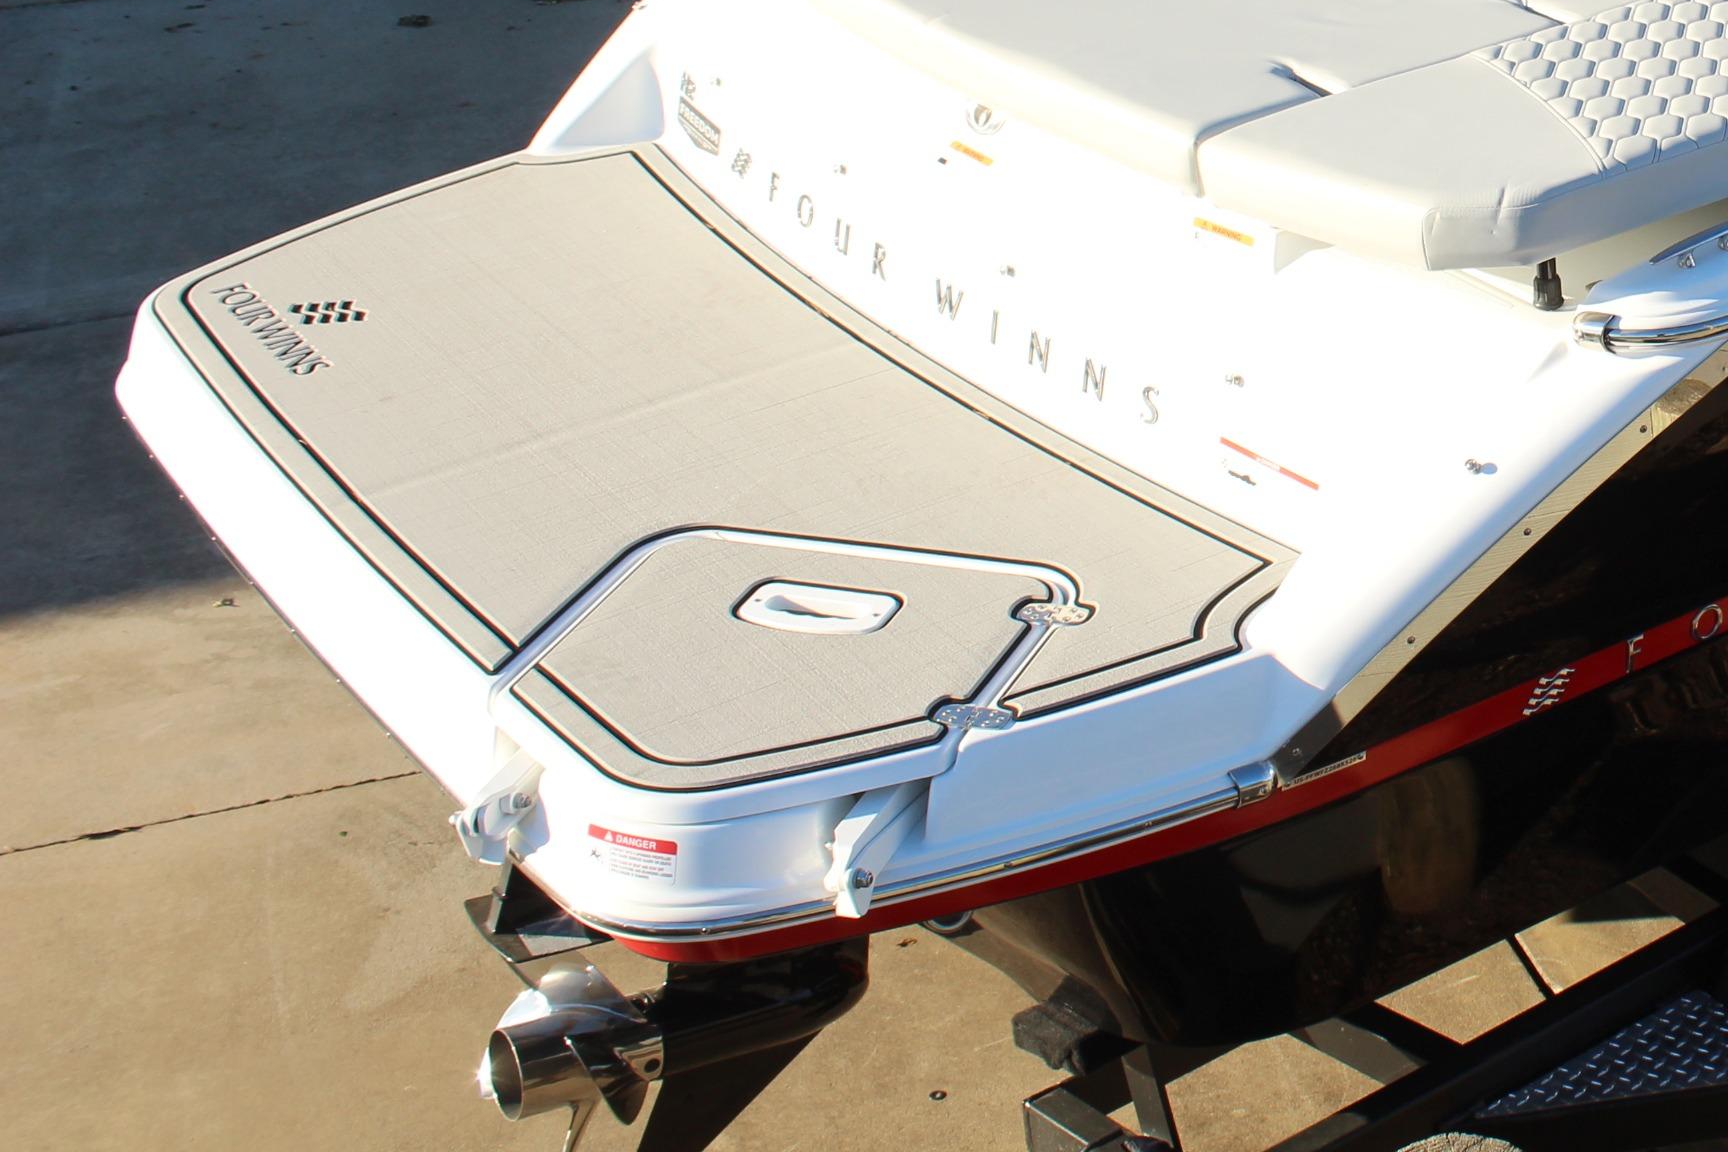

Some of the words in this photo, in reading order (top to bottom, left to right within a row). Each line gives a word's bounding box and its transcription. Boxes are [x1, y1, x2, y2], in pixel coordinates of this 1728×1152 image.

[679, 101, 720, 146] FREEDOM
[768, 171, 886, 281] FOUR
[935, 277, 1163, 425] WINNS
[615, 834, 657, 851] DANGER
